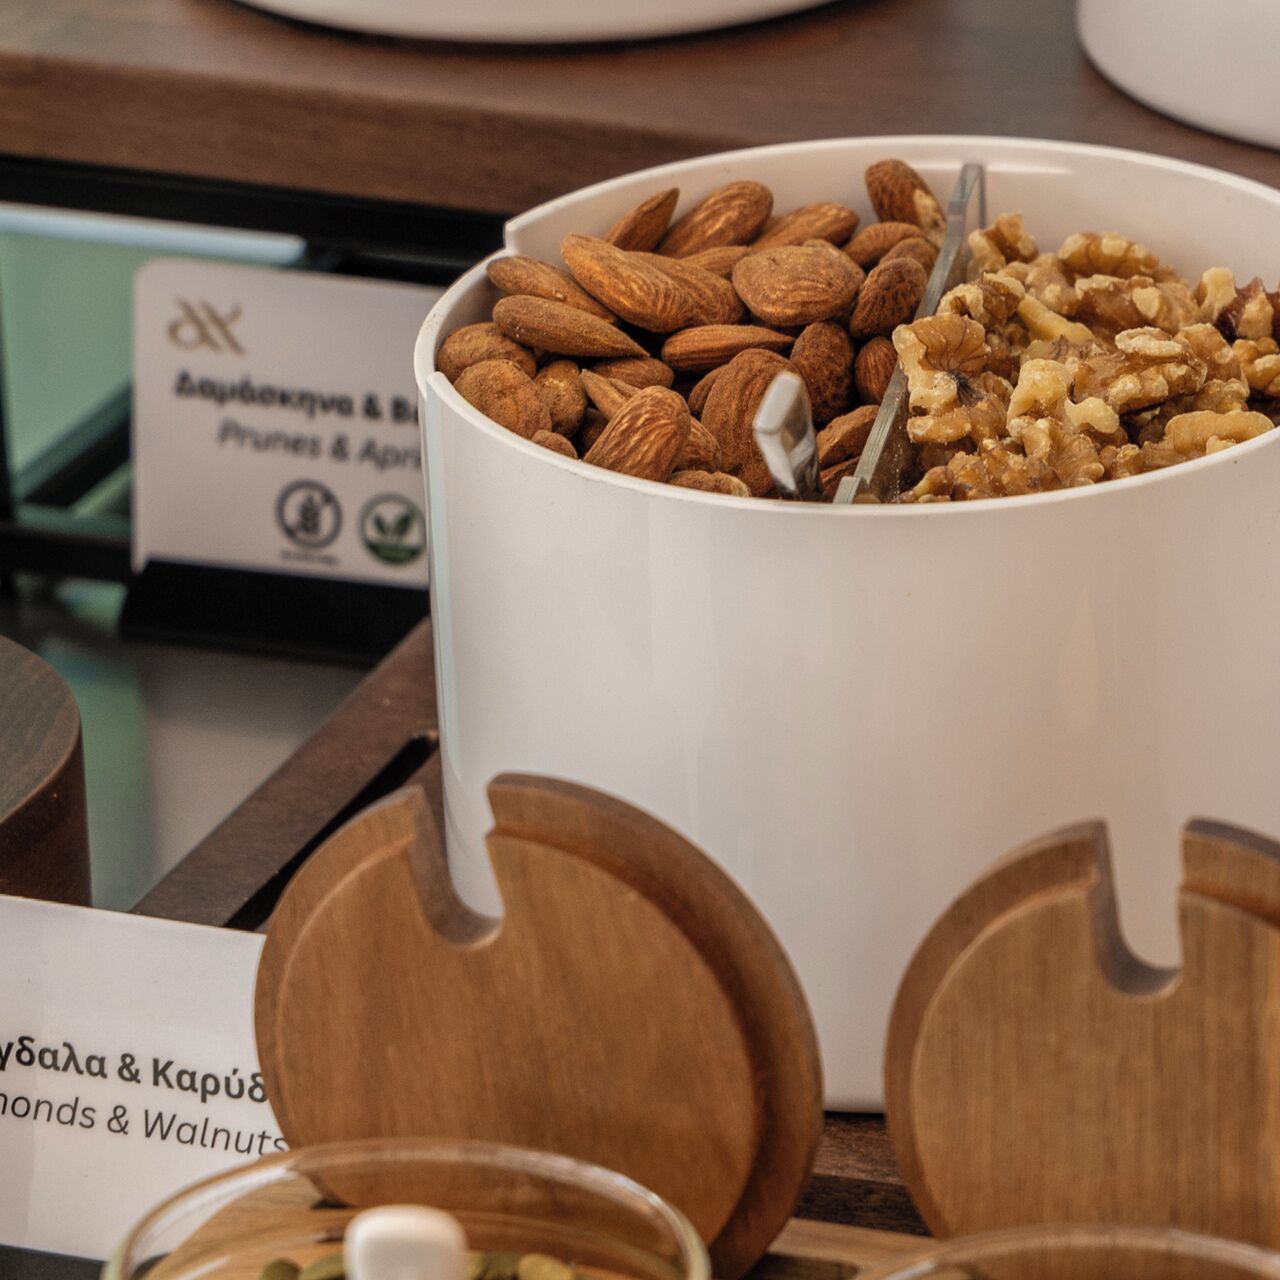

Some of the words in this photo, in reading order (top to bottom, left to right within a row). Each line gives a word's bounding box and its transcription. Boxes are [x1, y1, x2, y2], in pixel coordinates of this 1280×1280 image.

[174, 368, 355, 420] Δαμάσκηνα
[362, 391, 383, 421] &
[217, 418, 322, 460] Prunes
[329, 432, 350, 463] &
[118, 1053, 140, 1083] &
[152, 1058, 268, 1103] Καρύδ
[107, 1105, 129, 1135] &
